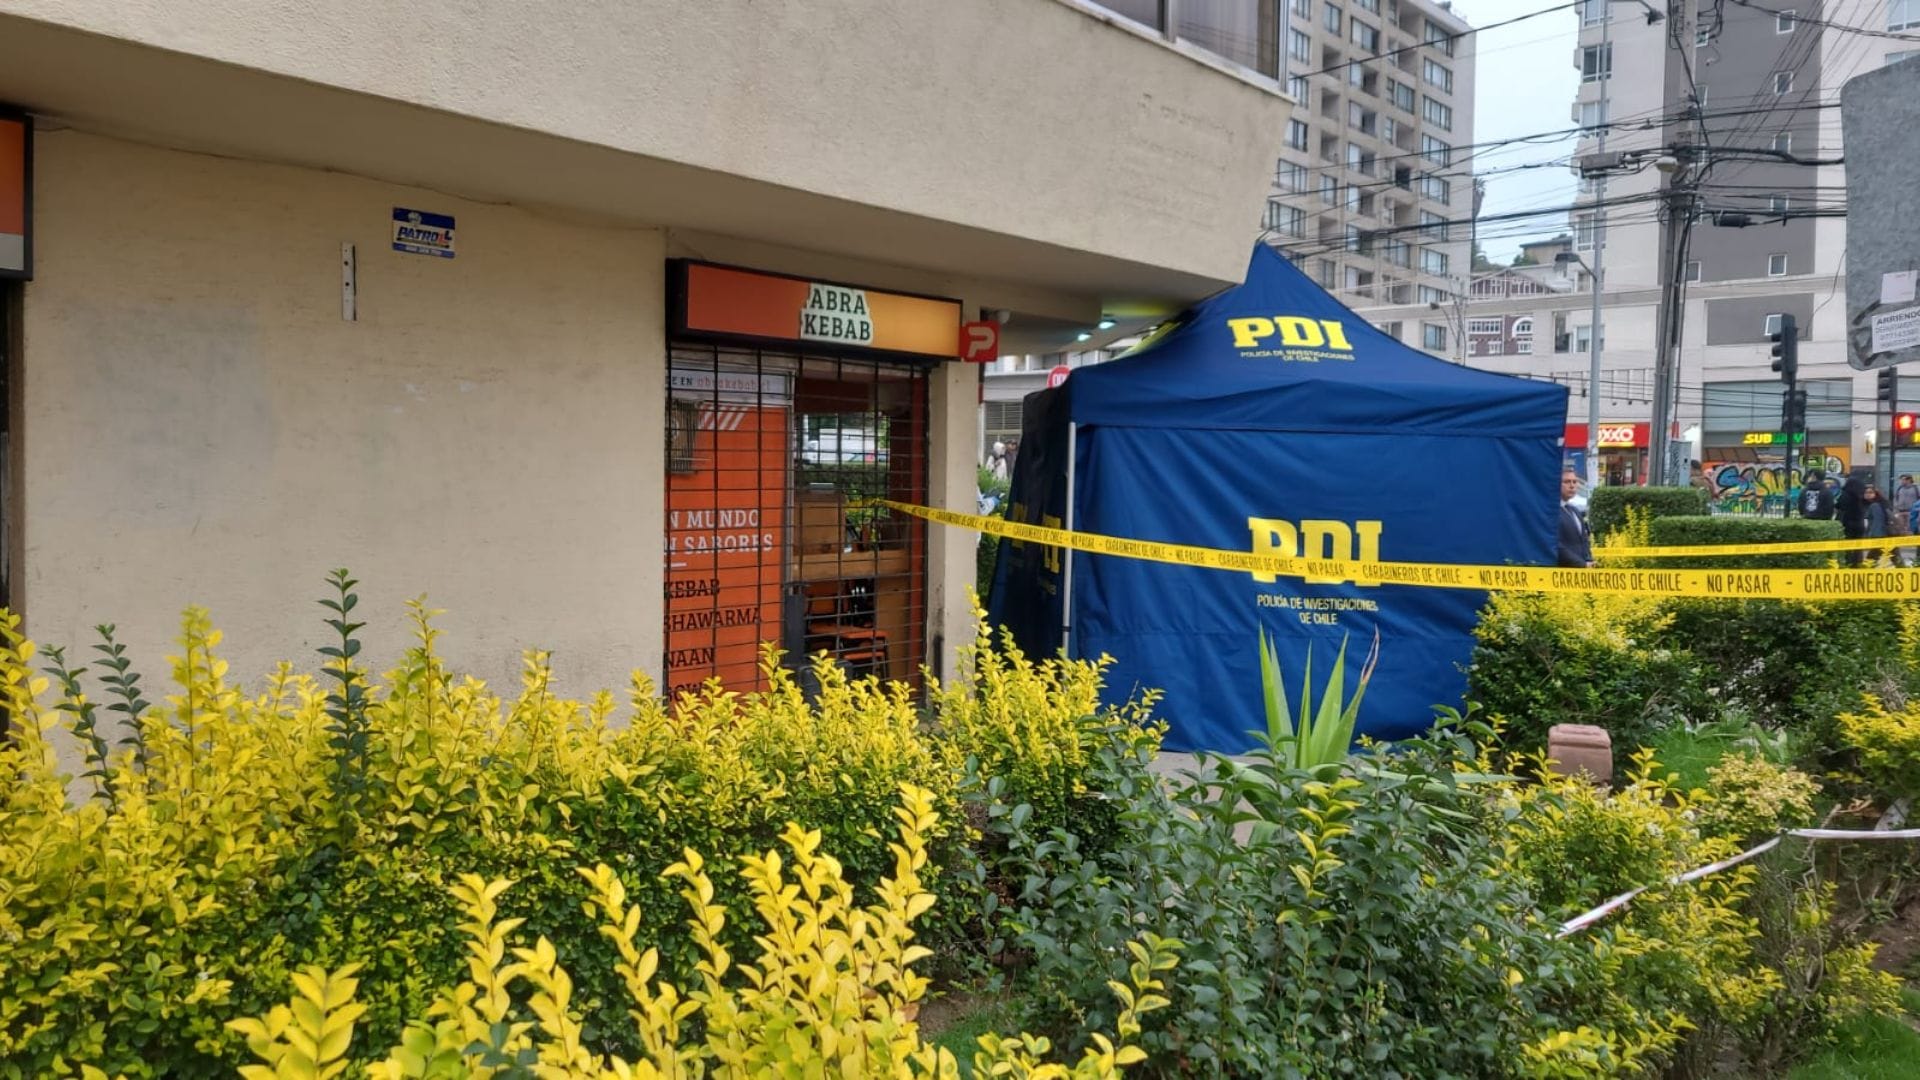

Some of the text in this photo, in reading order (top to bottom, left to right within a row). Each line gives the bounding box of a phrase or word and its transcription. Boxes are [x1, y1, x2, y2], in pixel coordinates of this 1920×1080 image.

[811, 289, 866, 315] ABRA
[804, 315, 871, 341] KEBAB
[1227, 316, 1353, 350] PDI
[1742, 433, 1805, 444] SUBWY
[687, 509, 760, 528] MUNDO
[684, 534, 773, 554] SABORES
[1248, 517, 1382, 586] PDI
[1274, 559, 1294, 573] CHILE
[1307, 562, 1317, 575] NO
[1319, 563, 1345, 577] PASAR
[1362, 564, 1420, 582] CARABINEROS
[1424, 567, 1434, 583] DE
[1436, 567, 1462, 584] CHILE
[1480, 570, 1492, 585] NO
[1495, 570, 1528, 587] PASAR
[1552, 571, 1626, 591] CARABINEROS
[1630, 573, 1645, 590] DE
[1648, 573, 1682, 591] CHILE
[1707, 574, 1722, 593] NO
[1727, 574, 1771, 593] PASAR
[1804, 572, 1905, 593] CARABINEROS
[1290, 597, 1303, 610] DE
[1303, 598, 1379, 612] INVESTIGACIONES
[1299, 612, 1338, 625] DE CHILE
